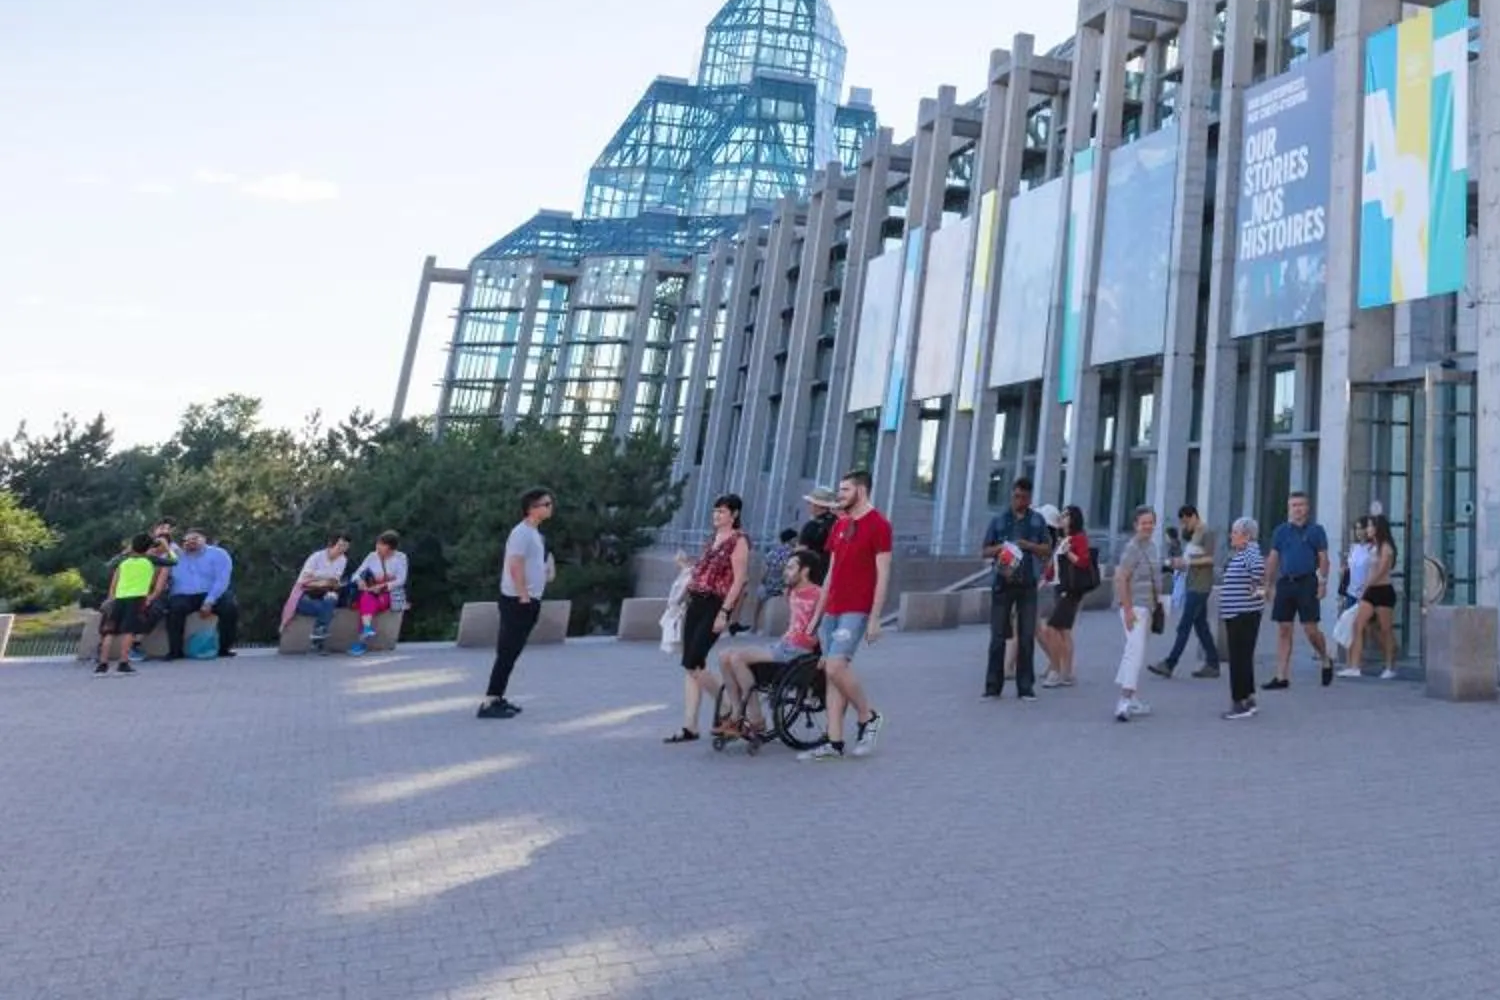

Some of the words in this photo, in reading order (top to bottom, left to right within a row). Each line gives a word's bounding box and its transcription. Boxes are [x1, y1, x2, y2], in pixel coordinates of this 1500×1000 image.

[1246, 127, 1277, 164] OUR
[1244, 145, 1308, 197] STORIES
[1252, 187, 1284, 224] NOS
[1240, 205, 1325, 260] HISTOIRES
